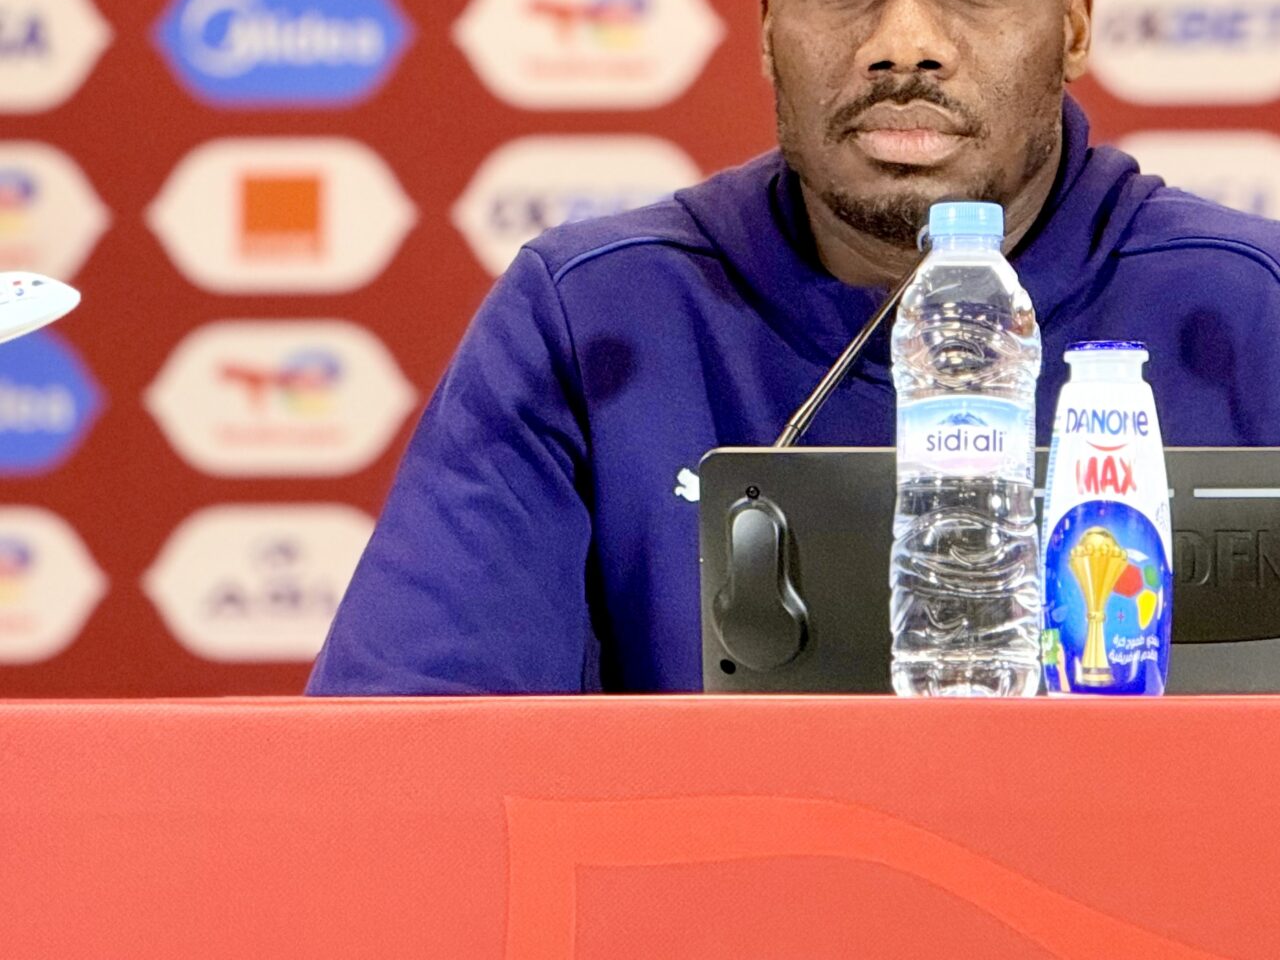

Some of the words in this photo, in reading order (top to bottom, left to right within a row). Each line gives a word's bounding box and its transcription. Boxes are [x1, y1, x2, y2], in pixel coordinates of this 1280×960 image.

[926, 428, 969, 452] sidi
[973, 429, 1003, 452] ali
[1075, 455, 1137, 496] MAX
